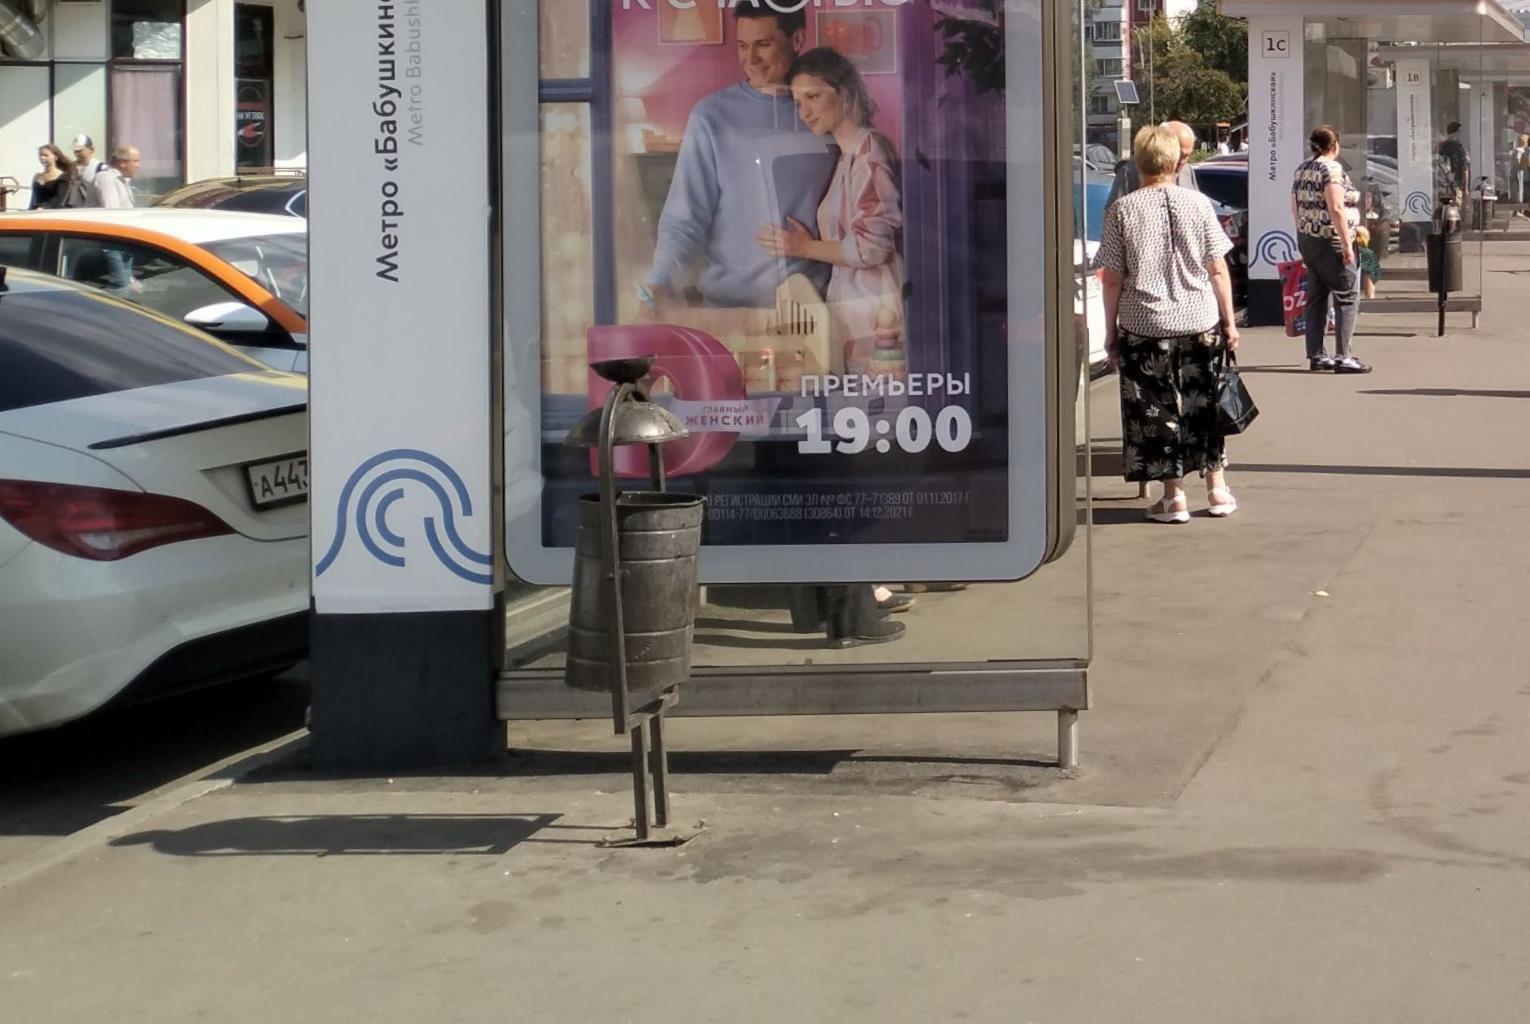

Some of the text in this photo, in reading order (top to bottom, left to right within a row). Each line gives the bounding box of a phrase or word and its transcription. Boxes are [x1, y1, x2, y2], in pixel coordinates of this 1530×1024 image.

[406, 82, 423, 147] Metro
[375, 180, 404, 282] Метро
[801, 372, 971, 398] ПРЕМЬЕРЫ
[686, 412, 764, 426] ЖЕНСКИЙ
[796, 404, 973, 454] 19:00
